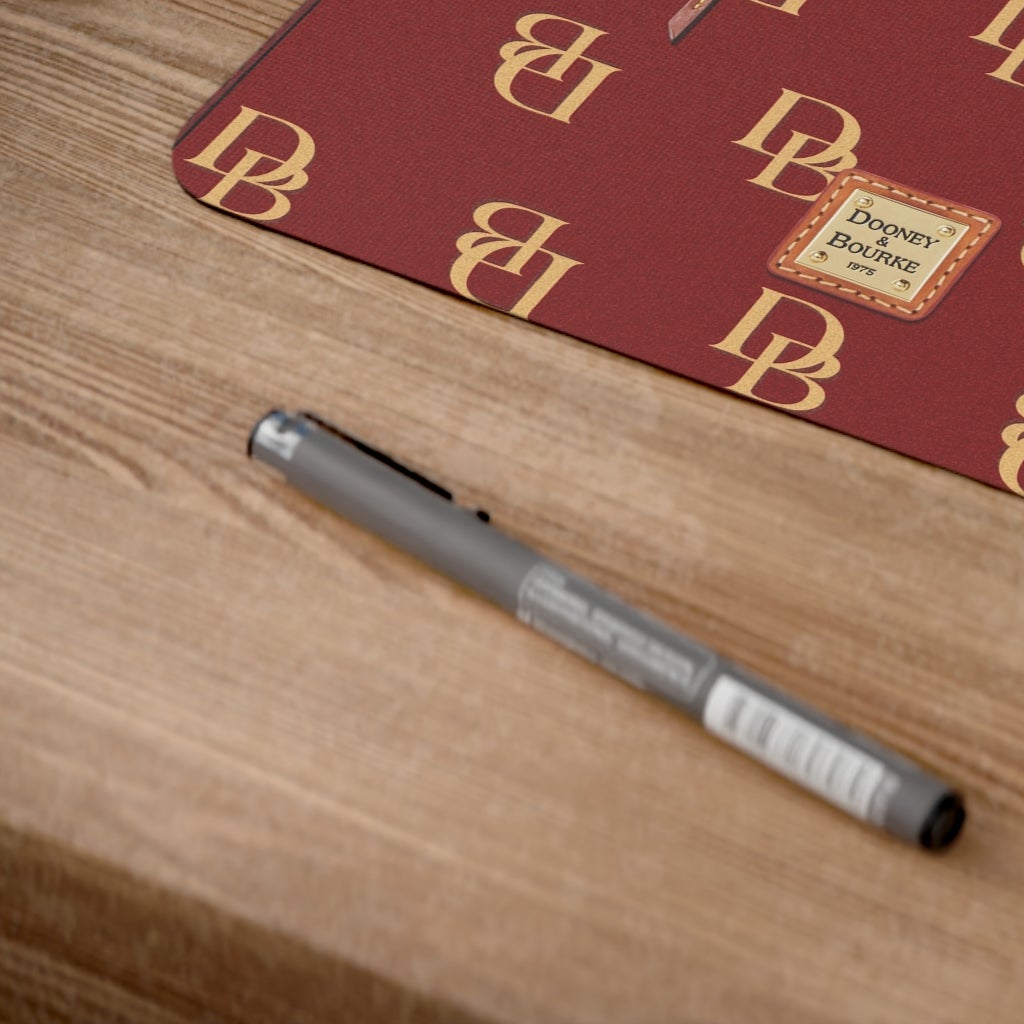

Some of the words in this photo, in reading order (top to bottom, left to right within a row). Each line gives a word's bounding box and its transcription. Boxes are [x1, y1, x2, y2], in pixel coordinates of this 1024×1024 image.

[846, 208, 940, 249] DOONEY
[876, 236, 889, 248] &
[826, 231, 920, 274] BOURKE
[846, 261, 876, 277] 1975
